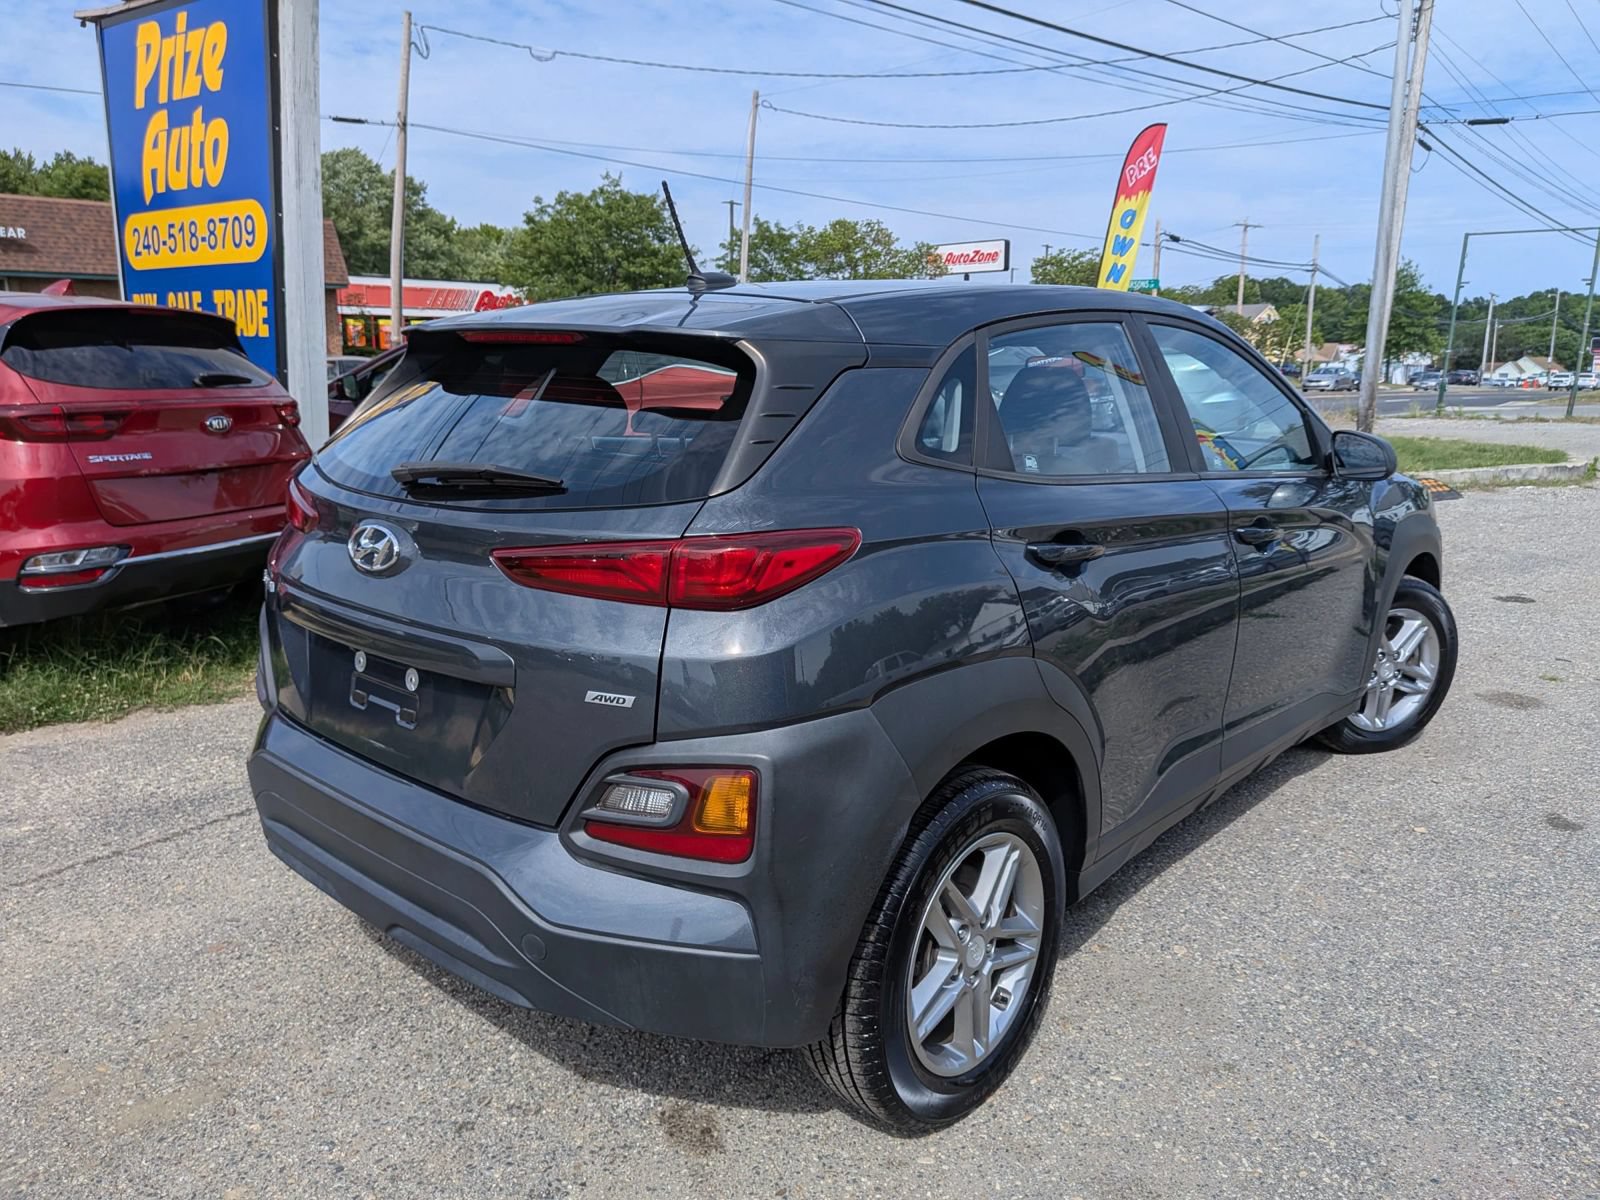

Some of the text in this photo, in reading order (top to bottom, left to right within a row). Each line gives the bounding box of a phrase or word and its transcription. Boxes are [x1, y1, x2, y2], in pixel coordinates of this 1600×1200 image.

[134, 11, 228, 110] Prize
[142, 106, 229, 205] Auto
[1125, 146, 1158, 187] PRE
[0, 226, 26, 239] EAR
[132, 214, 257, 257] 240-518-8709
[1105, 208, 1137, 284] OWN
[944, 249, 999, 265] AutoZone
[213, 289, 269, 337] TRADE
[87, 452, 152, 463] SPORTAGE
[590, 694, 626, 705] AWD
